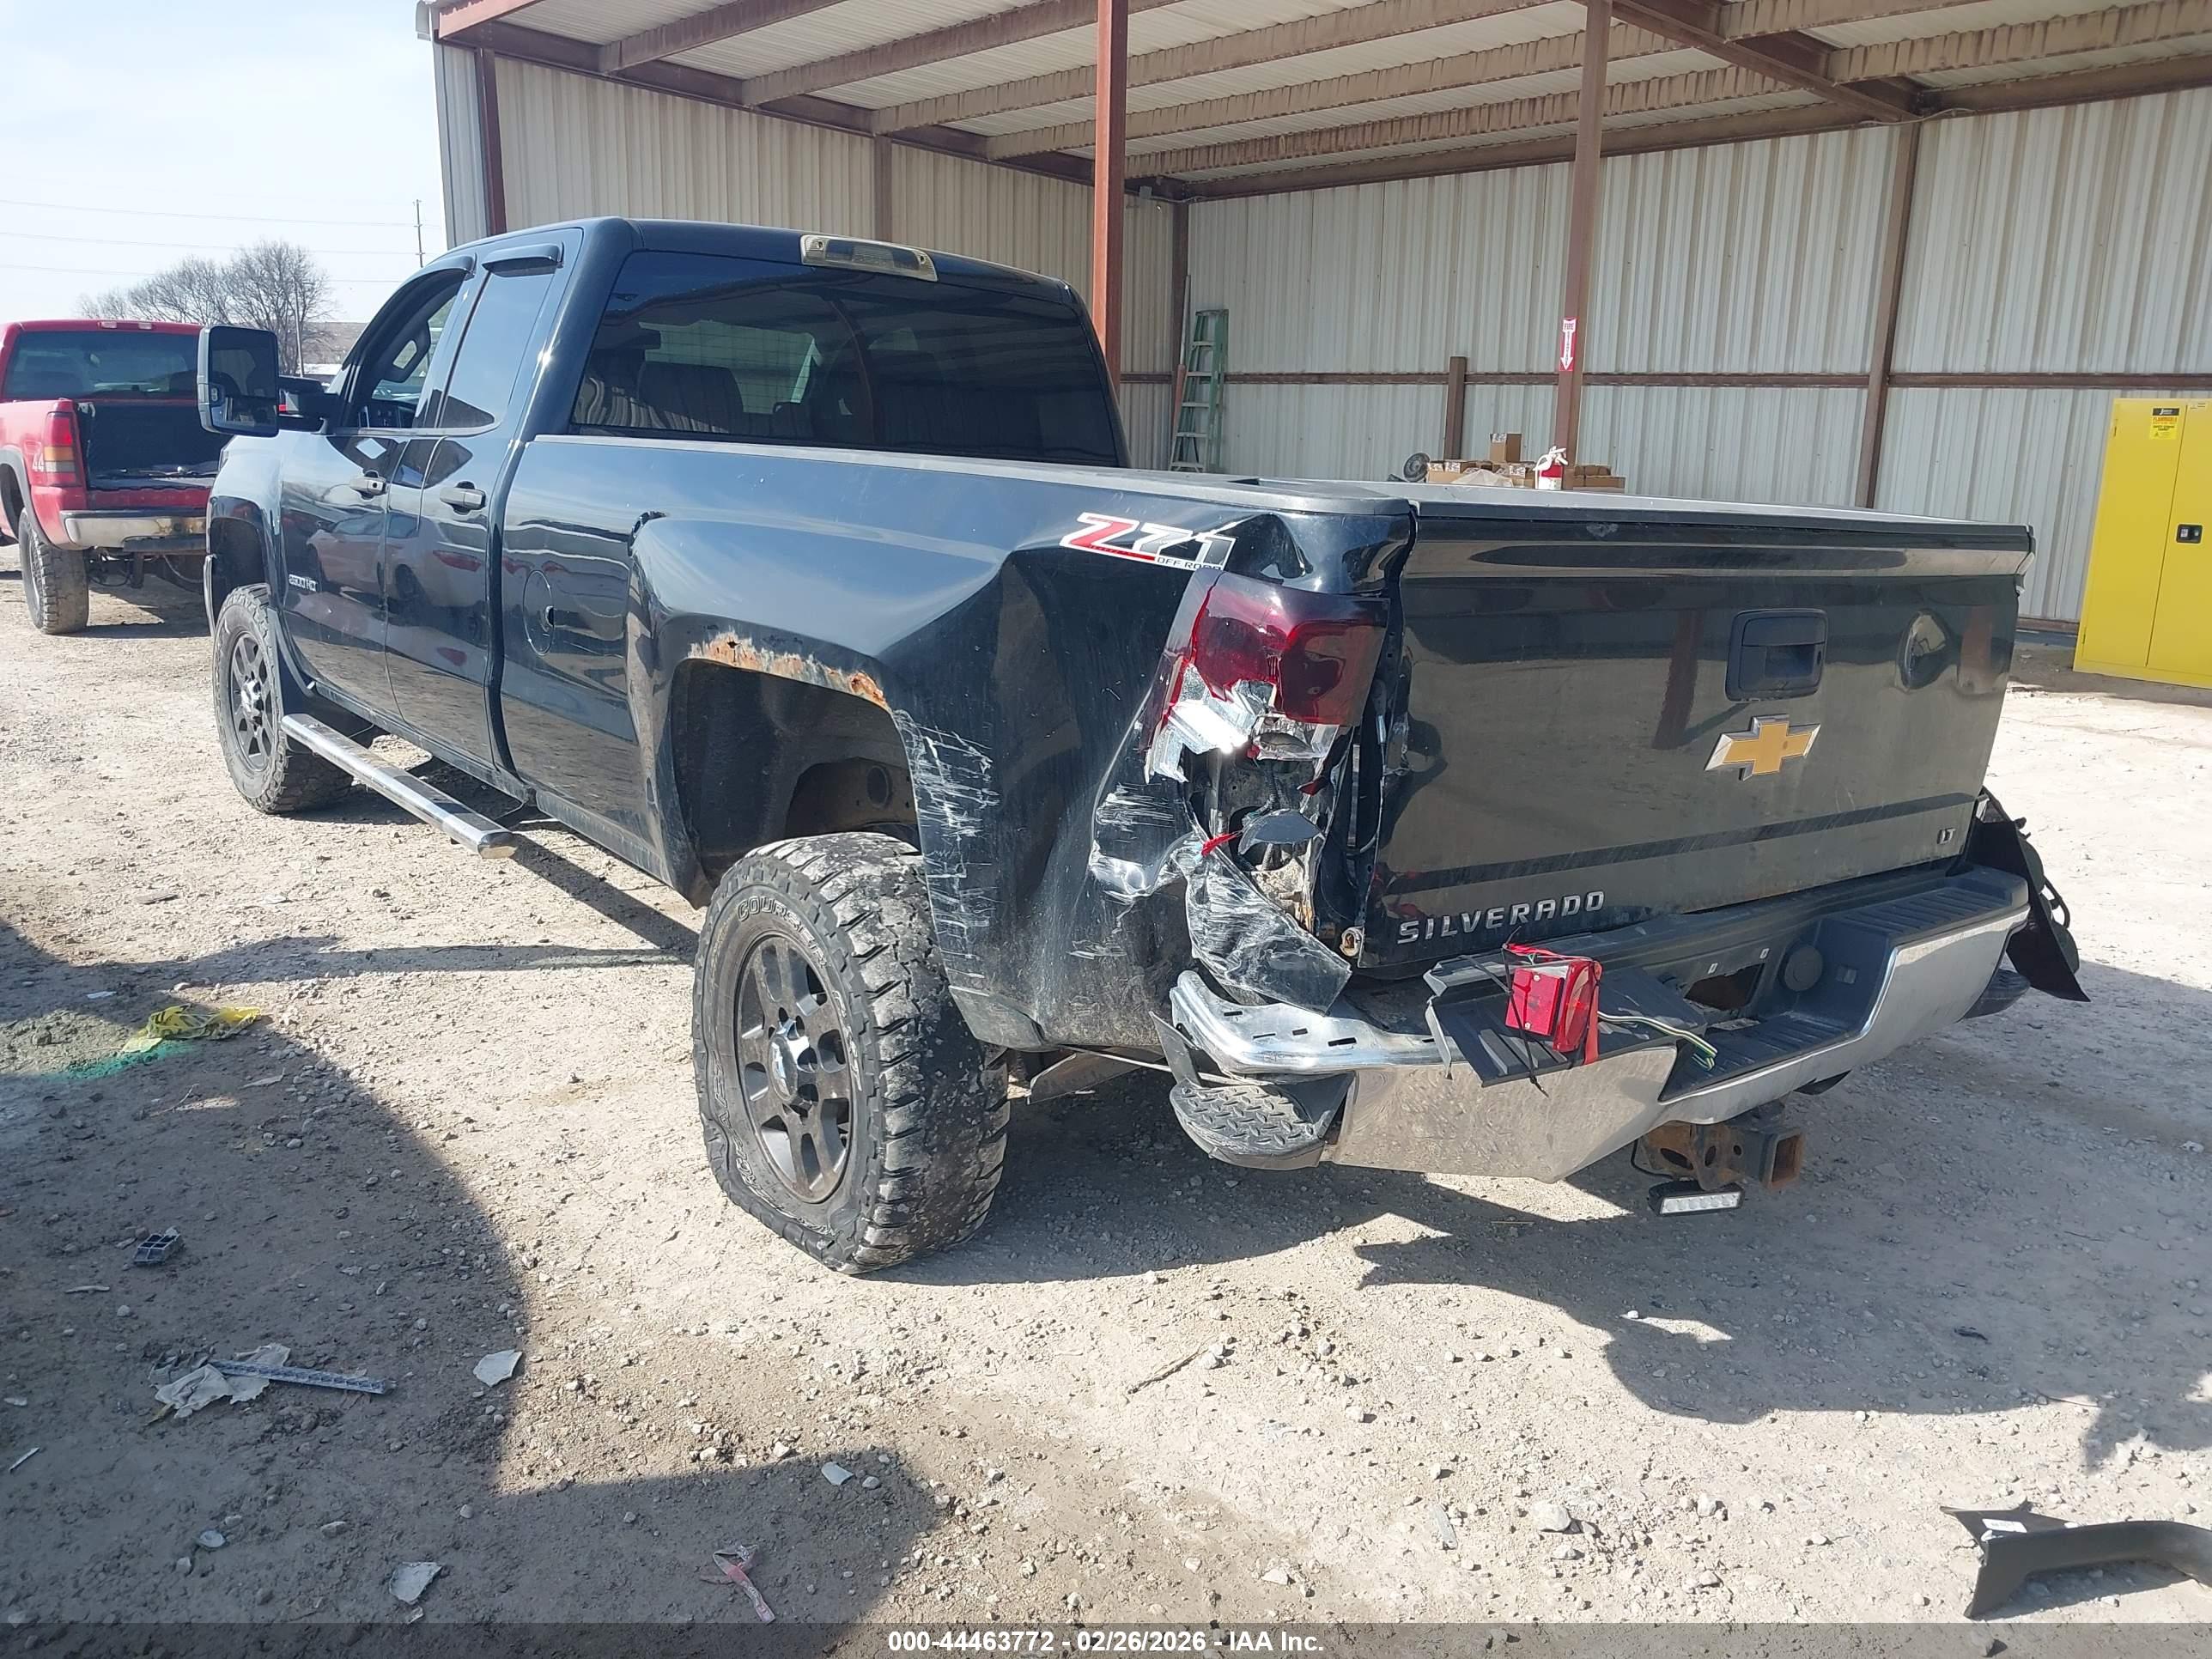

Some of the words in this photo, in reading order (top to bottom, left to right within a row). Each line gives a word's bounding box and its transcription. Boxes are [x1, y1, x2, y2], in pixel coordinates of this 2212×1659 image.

[1059, 512, 1237, 568] Z71
[1156, 556, 1182, 567] OFF
[1937, 828, 1956, 844] LT
[738, 896, 828, 969] COURSER
[1397, 890, 1605, 944] SILVERADO
